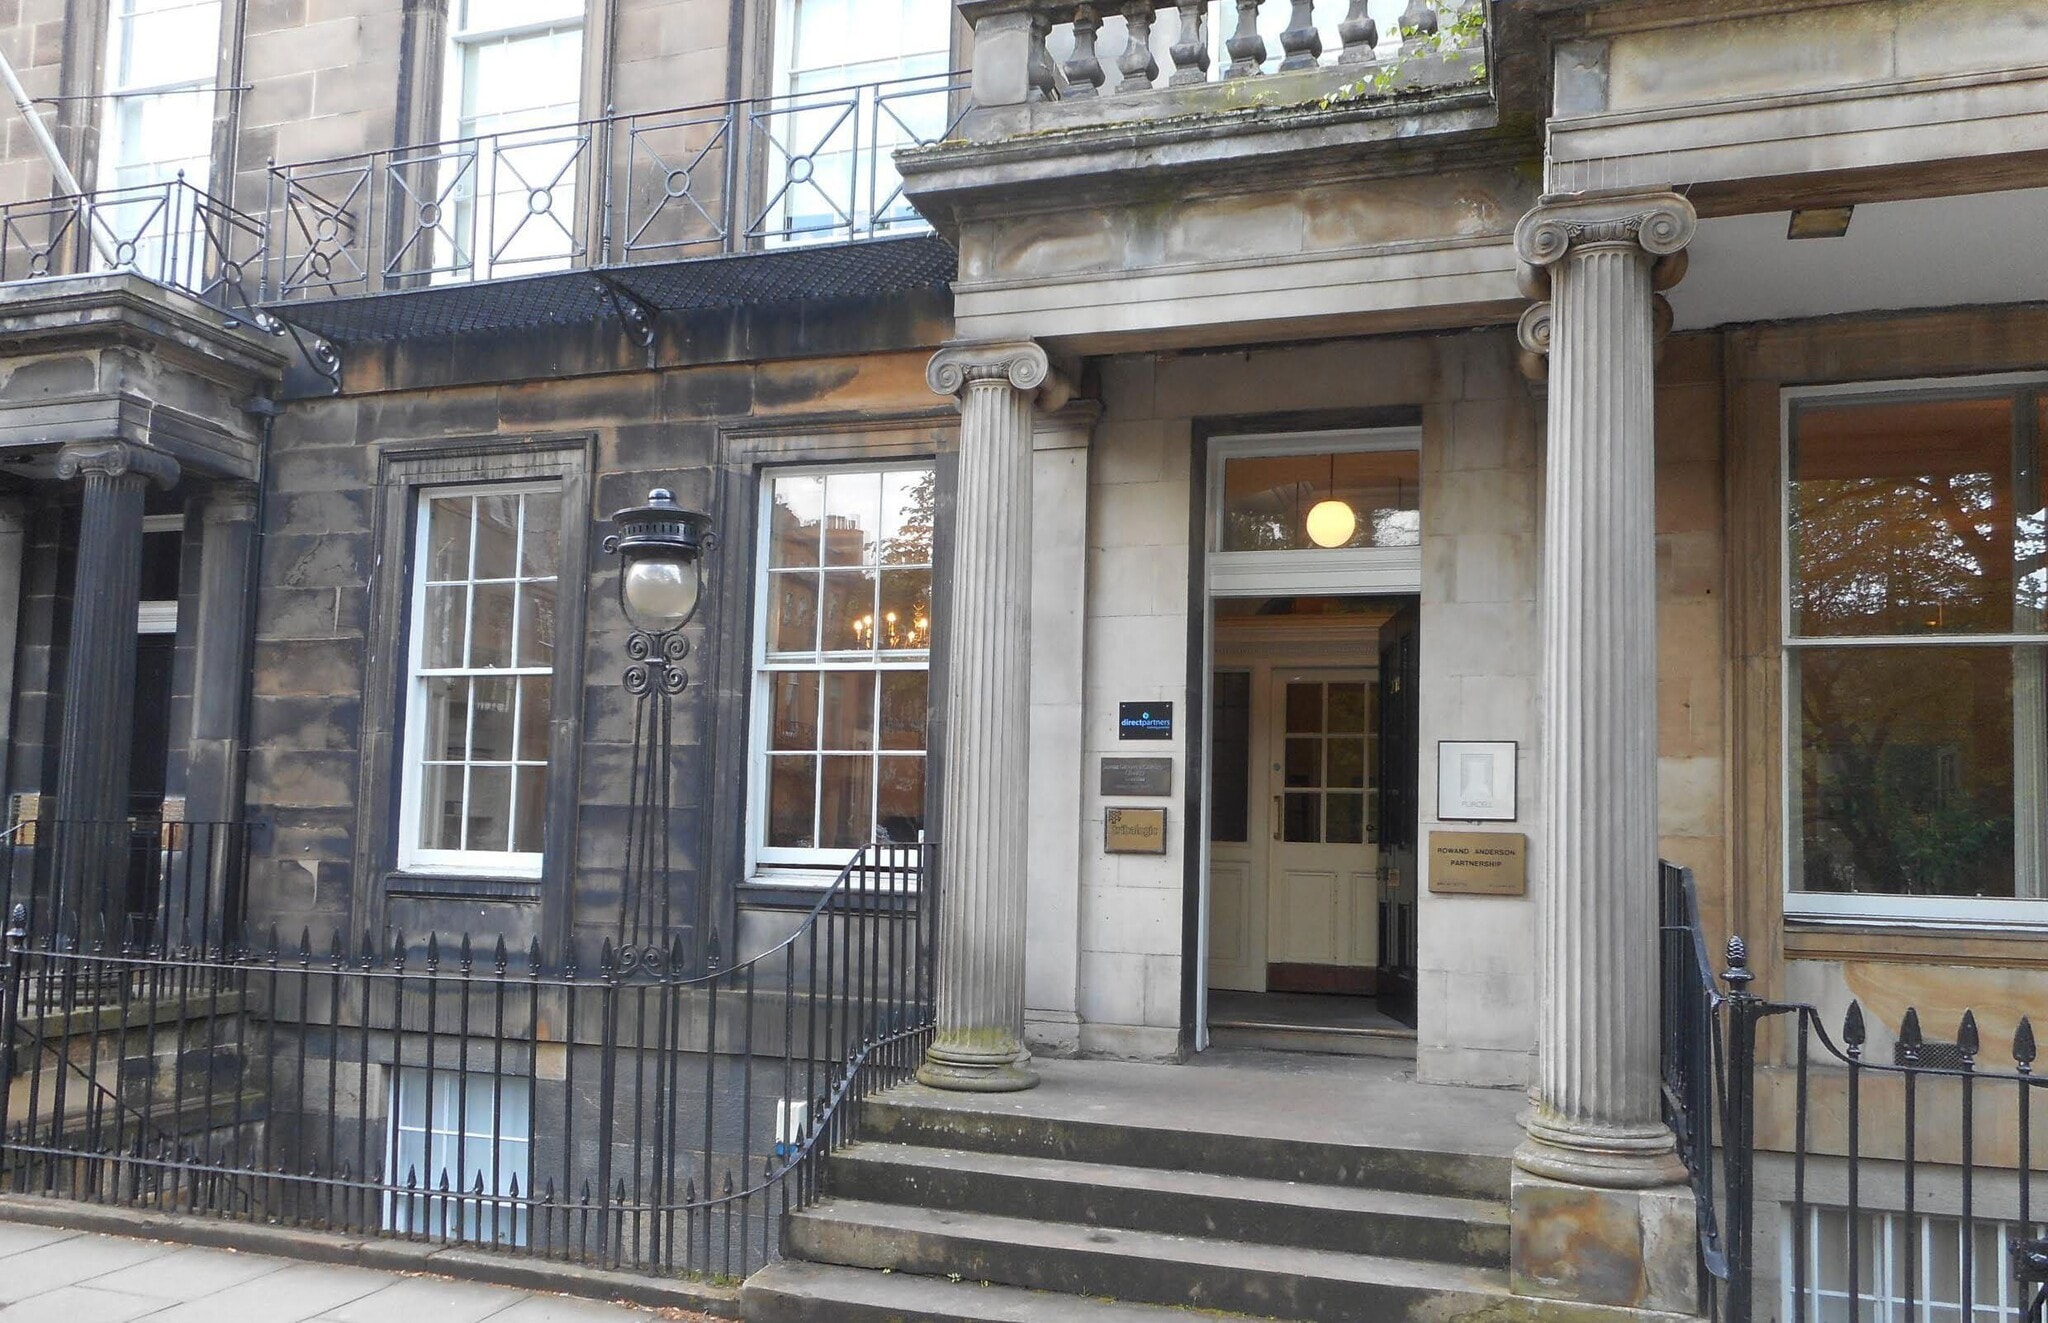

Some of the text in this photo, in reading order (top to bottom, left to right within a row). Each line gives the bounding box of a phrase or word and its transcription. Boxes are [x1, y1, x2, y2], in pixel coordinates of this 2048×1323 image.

[1121, 718, 1170, 728] directpartners
[1437, 847, 1516, 856] ROWAND ANDERSON
[1450, 859, 1502, 868] PARTNERSHIP
